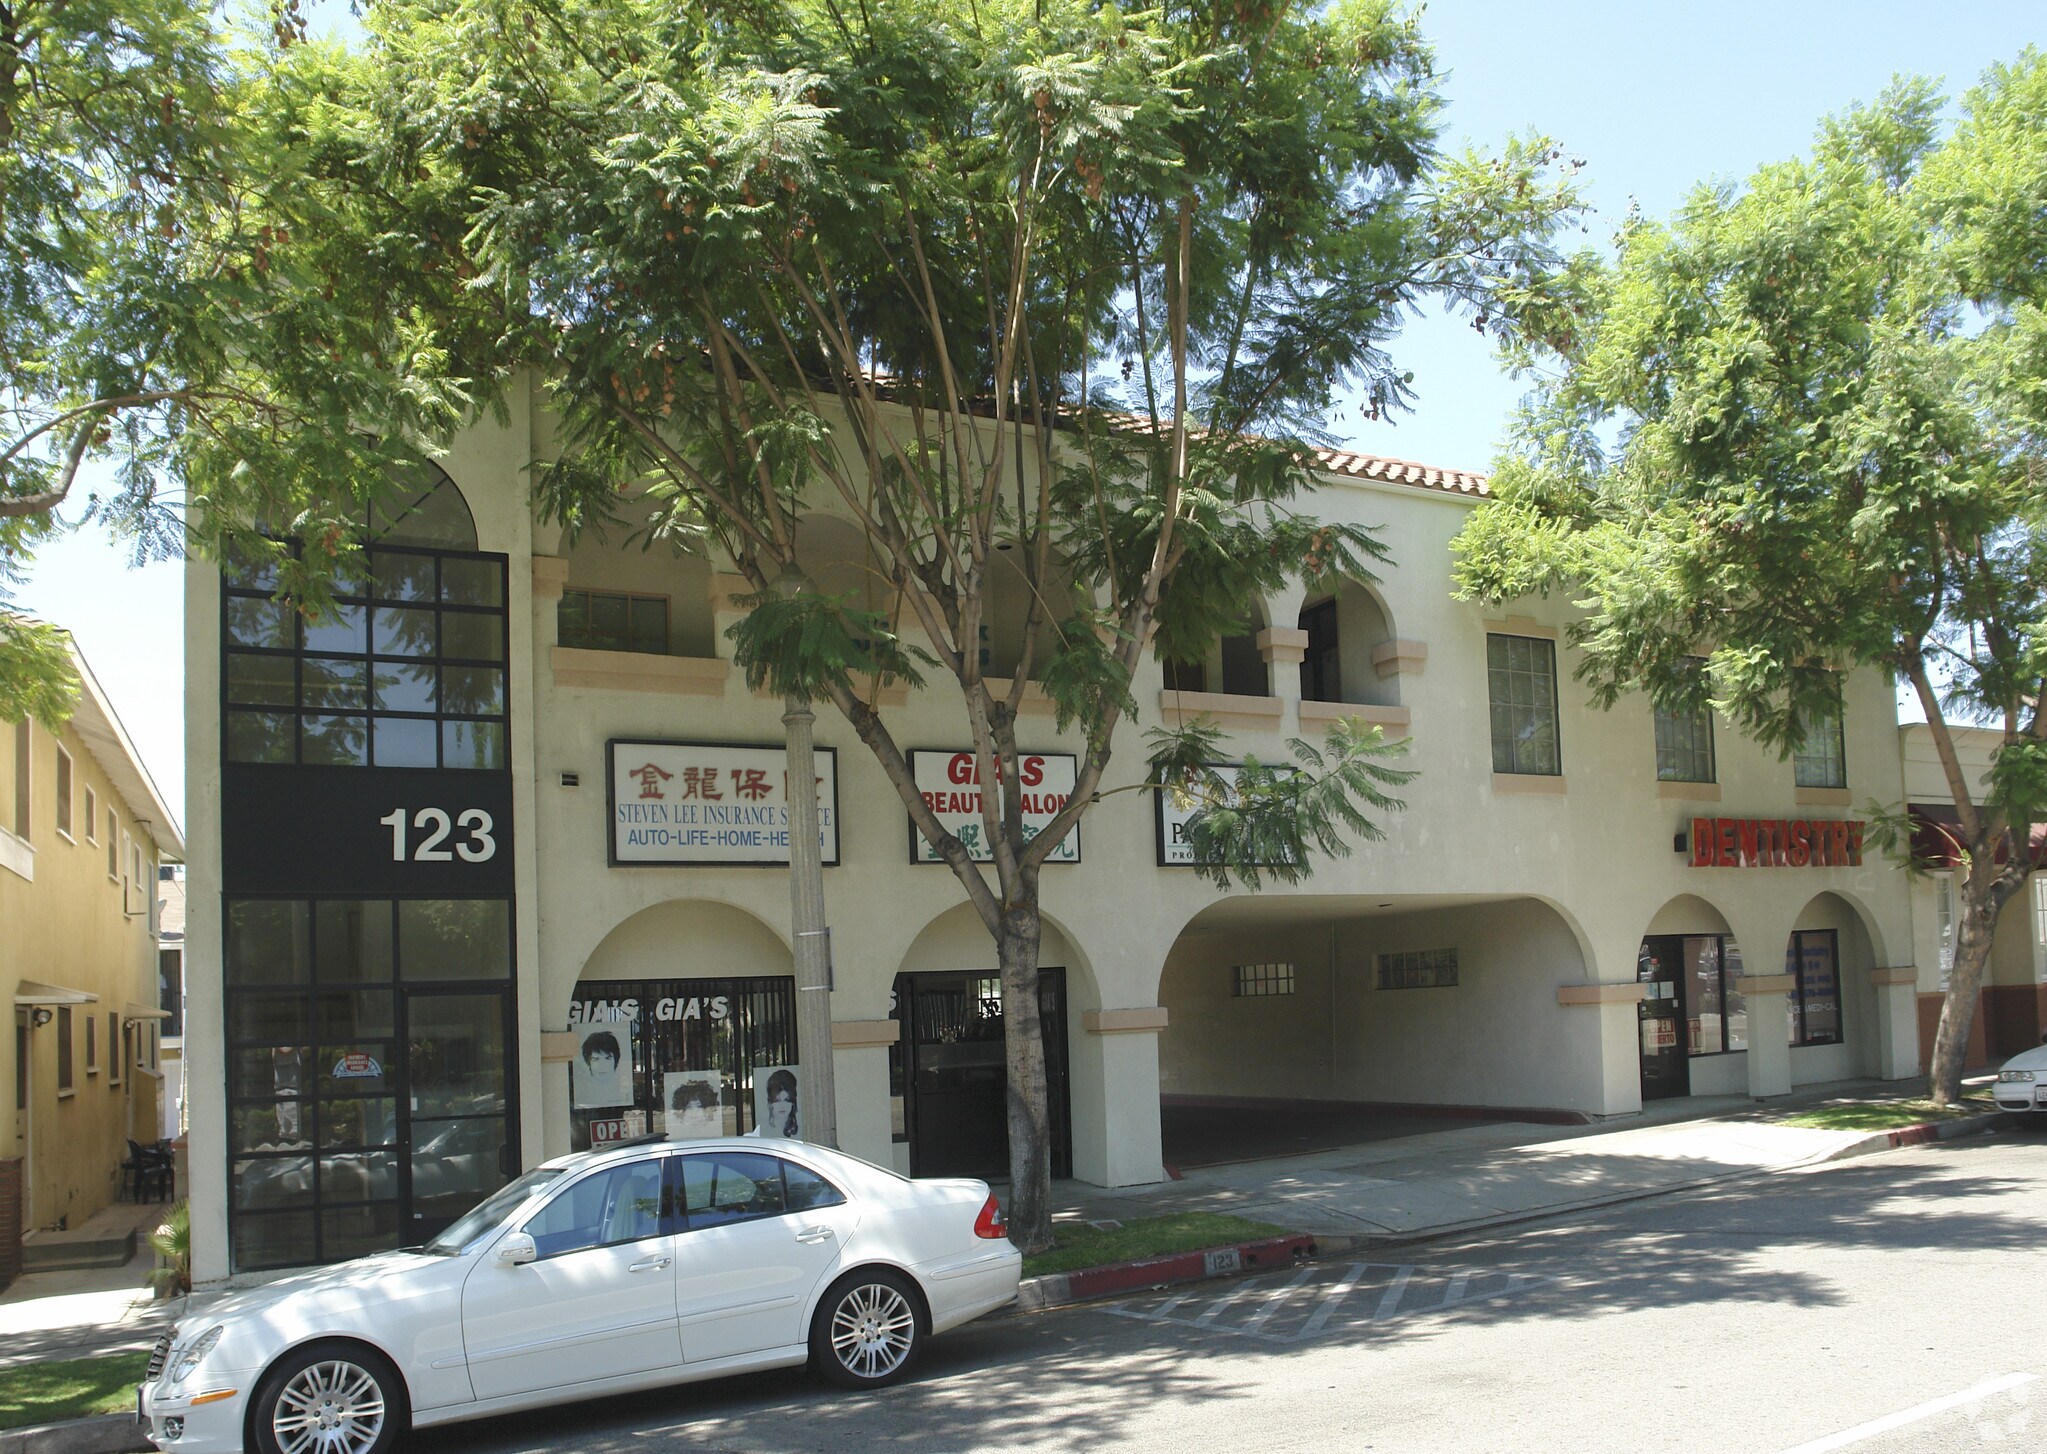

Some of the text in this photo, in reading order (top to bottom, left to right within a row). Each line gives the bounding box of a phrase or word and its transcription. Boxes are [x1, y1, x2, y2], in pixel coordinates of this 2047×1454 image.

[629, 763, 823, 801] 金龍保
[619, 804, 668, 823] STEVEN
[675, 805, 698, 824] LEE
[704, 806, 775, 826] INSURANCE
[922, 792, 1070, 815] BEAUT ALON
[380, 808, 496, 862] 123
[1688, 817, 1866, 868] DENTISTRY
[656, 996, 728, 1021] GIA'S
[597, 1120, 640, 1140] OPEN
[1213, 1253, 1234, 1270] 123
